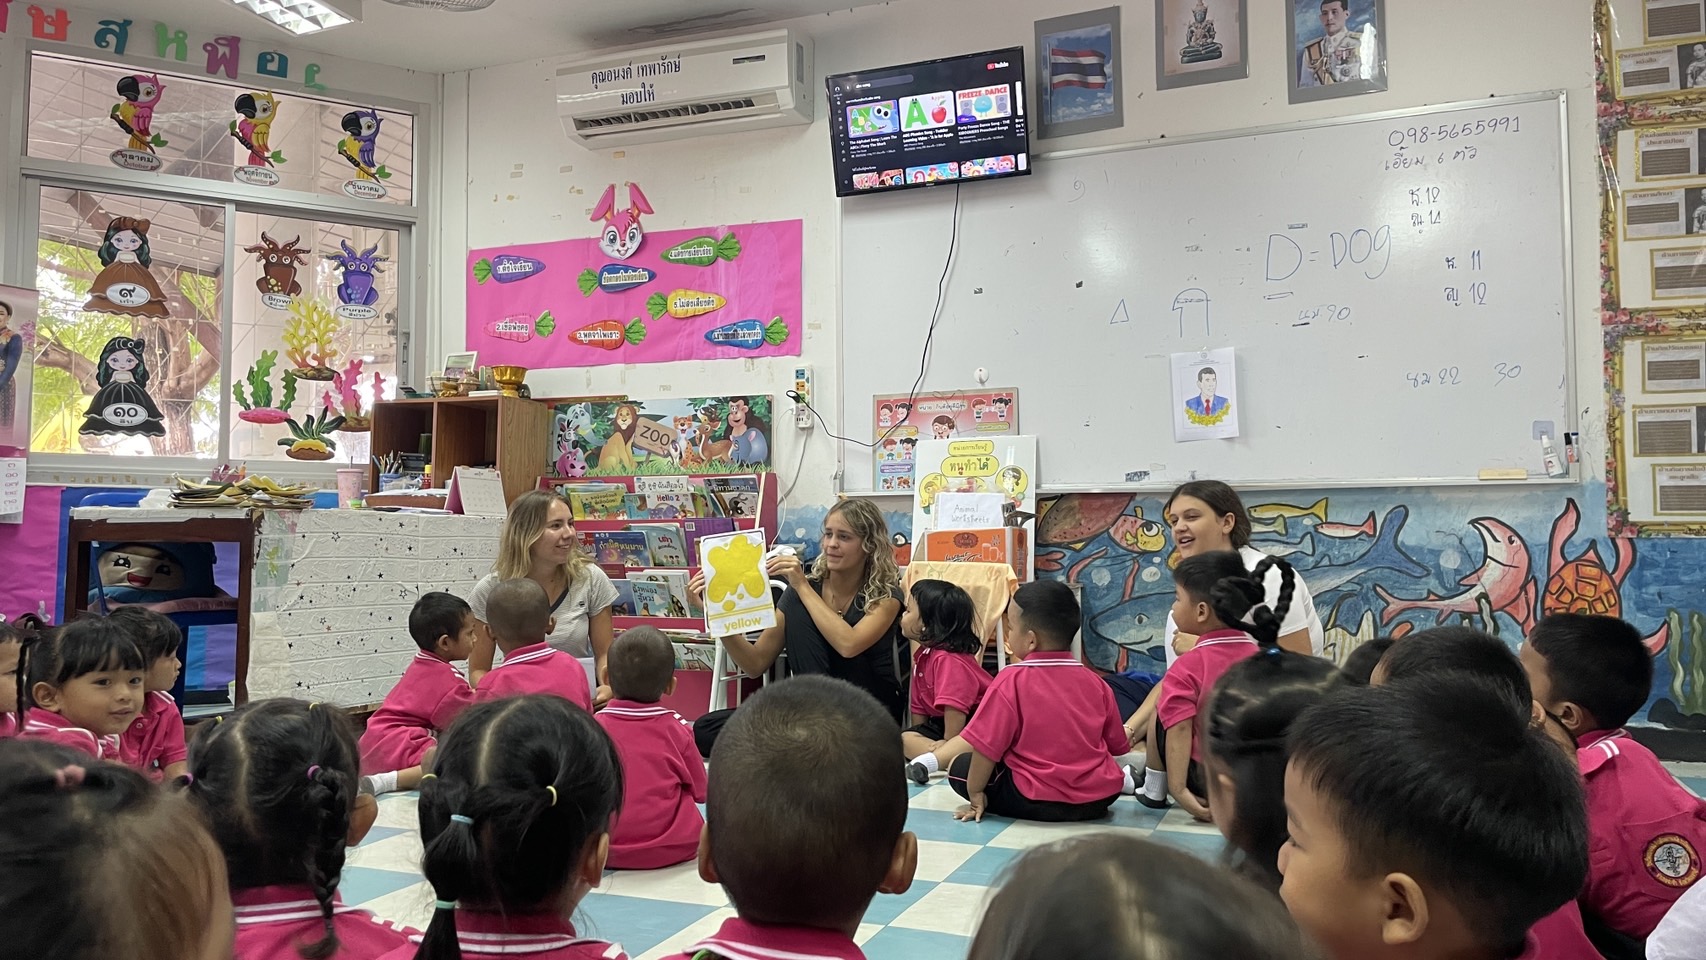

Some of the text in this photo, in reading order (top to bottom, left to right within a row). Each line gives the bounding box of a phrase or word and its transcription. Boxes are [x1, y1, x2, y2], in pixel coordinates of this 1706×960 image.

[94, 19, 133, 55] ส
[154, 22, 188, 61] ห
[257, 51, 288, 78] อ
[591, 54, 681, 89] คุณอนงค์ เทพารักษ์
[620, 82, 655, 105] มอบให้
[958, 86, 1007, 99] FREEZE DANCE
[1388, 116, 1520, 146] 098-5655991
[122, 154, 154, 163] ตุลาคม
[352, 182, 379, 192] ธันวาคม
[1266, 234, 1302, 282] D
[119, 286, 136, 298] ๙
[268, 296, 294, 304] Brown
[578, 328, 620, 342] 3.พูดจาไพเราะ
[1494, 362, 1522, 387] 30
[113, 407, 138, 418] ๑๐
[639, 425, 670, 447] ZOO
[953, 443, 987, 451] หน่วยการเรียนรู้
[950, 458, 990, 475] หนูทำได้
[954, 504, 978, 513] Animal
[724, 617, 761, 633] yellow
